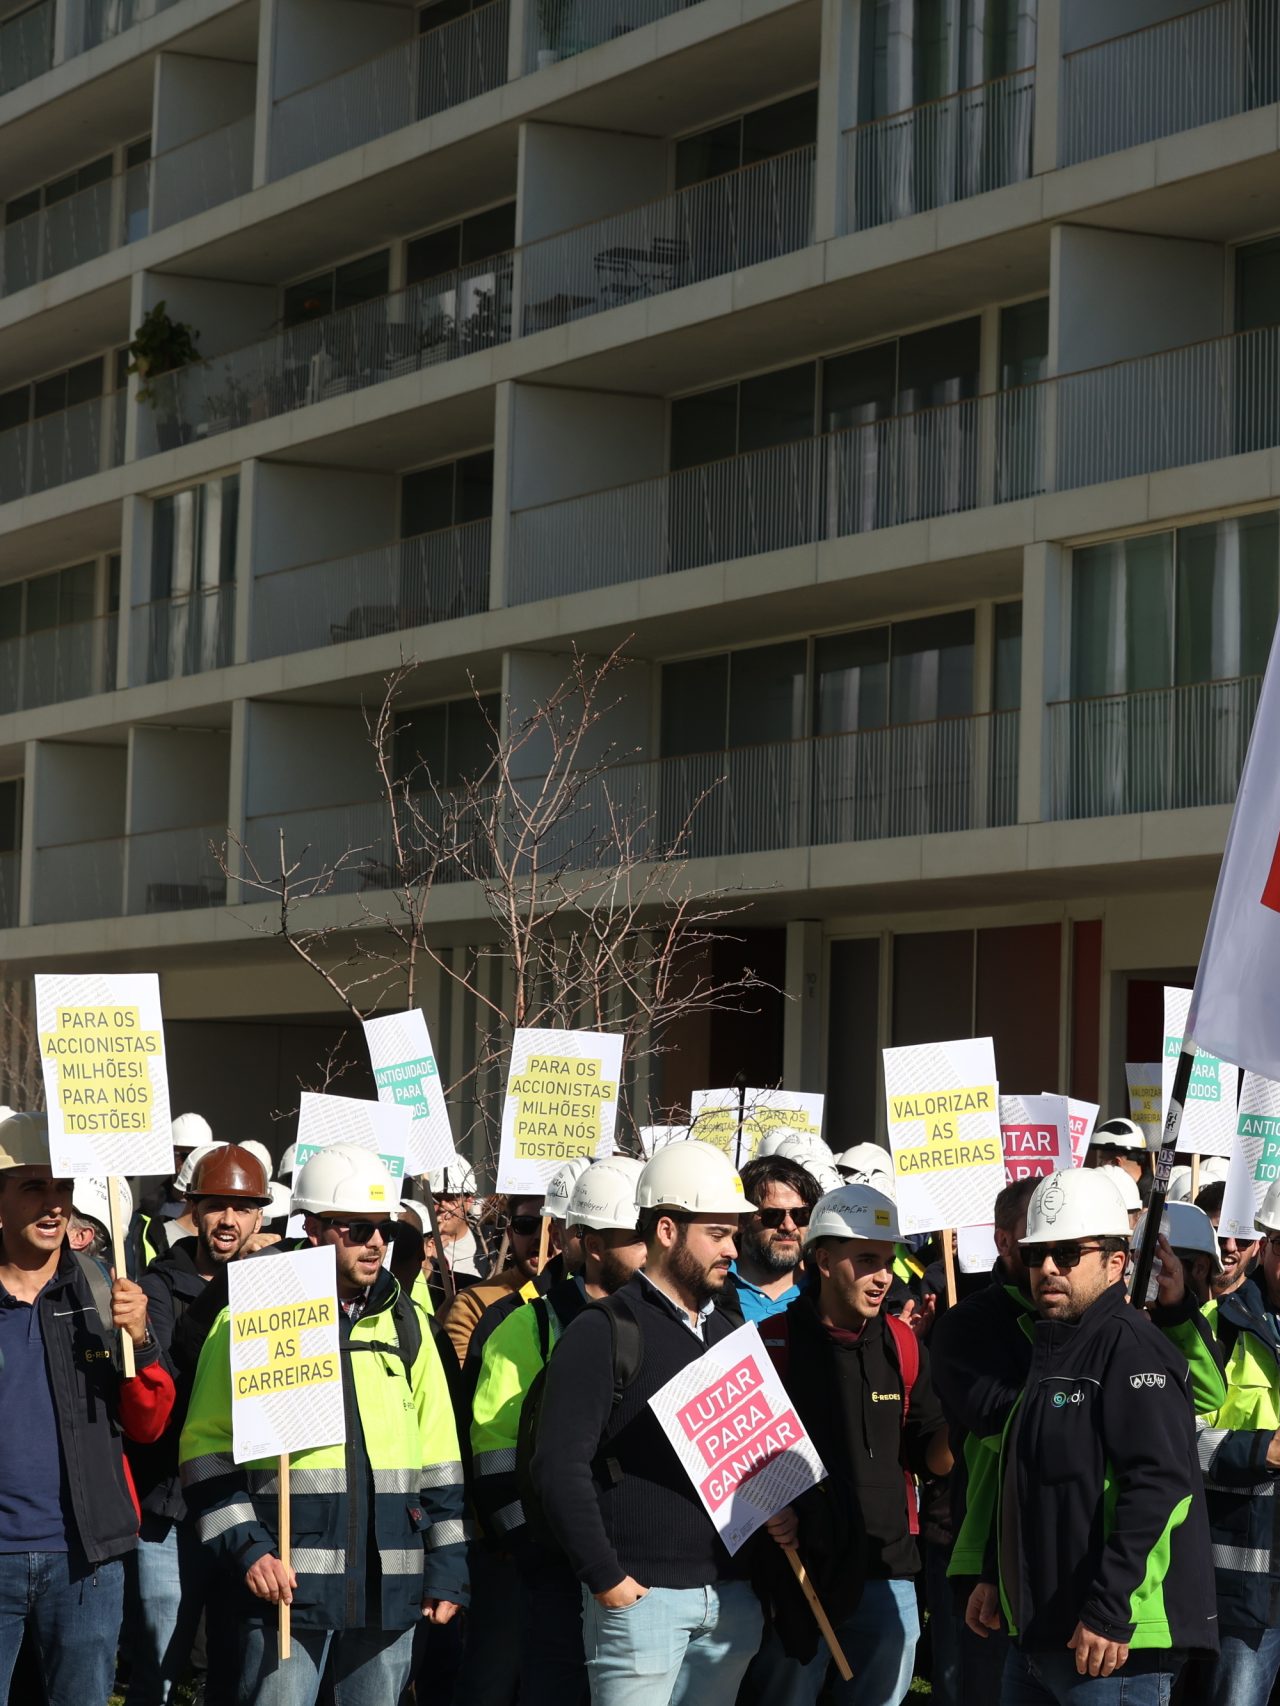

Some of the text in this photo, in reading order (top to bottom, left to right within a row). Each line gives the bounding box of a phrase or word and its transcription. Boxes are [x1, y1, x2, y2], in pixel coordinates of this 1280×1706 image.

[62, 1011, 135, 1029] PARA OS
[47, 1036, 156, 1054] ACCIONISTAS
[63, 1059, 143, 1079] MILHÕES!
[377, 1061, 434, 1085] ANTIGUIDADE
[530, 1060, 596, 1077] PARA OS
[63, 1084, 148, 1104] PARA NÓS
[395, 1085, 422, 1101] PARA
[512, 1080, 611, 1099] ACCIONISTAS
[522, 1100, 596, 1118] MILHÕES!
[894, 1092, 989, 1118] VALORIZAR
[68, 1109, 146, 1130] TOSTÕES!
[518, 1121, 596, 1138] PARA NÓS
[932, 1123, 953, 1140] AS
[899, 1144, 995, 1171] CARREIRAS
[237, 1304, 329, 1337] VALORIZAR
[274, 1339, 296, 1360] AS
[239, 1360, 333, 1394] CARREIRAS
[685, 1367, 755, 1431] LUTAR
[705, 1404, 766, 1459] PARA
[708, 1421, 797, 1501] GANHAR
